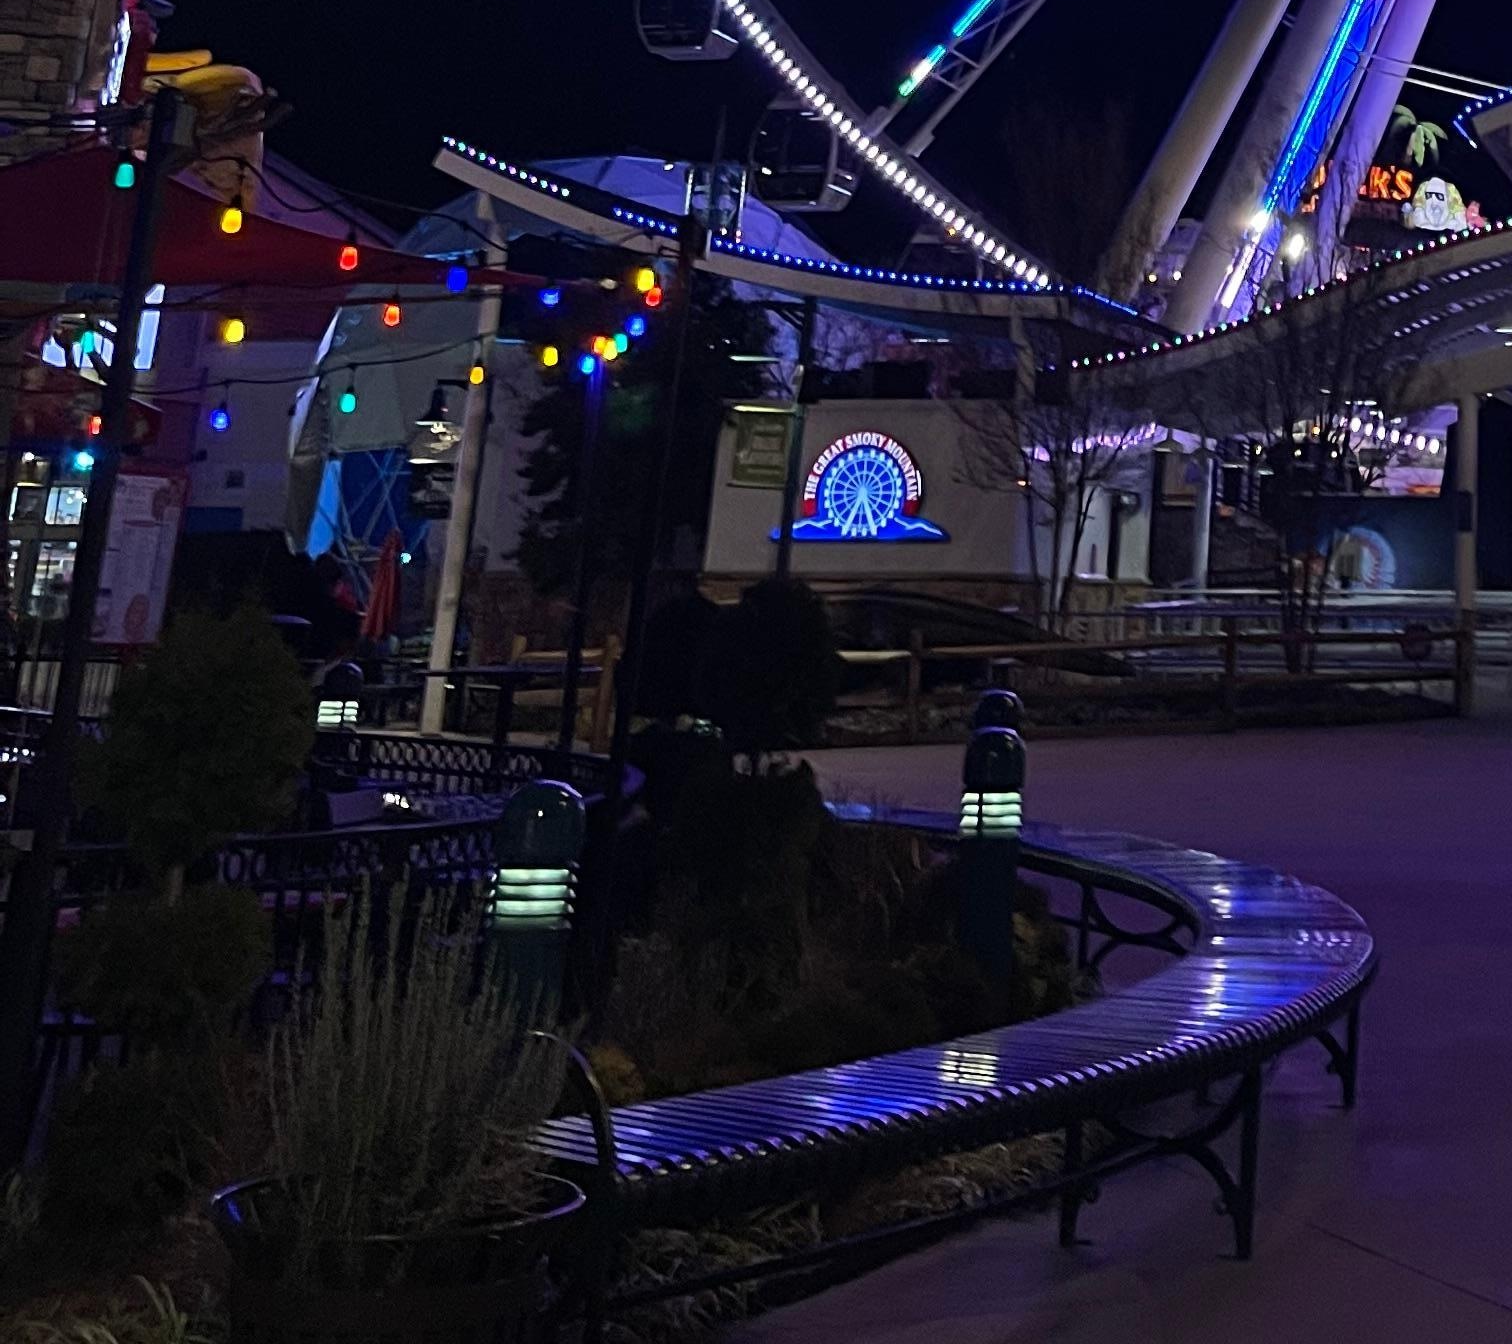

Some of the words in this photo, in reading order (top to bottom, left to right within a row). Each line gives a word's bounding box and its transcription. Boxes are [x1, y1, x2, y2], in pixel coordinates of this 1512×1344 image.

[804, 474, 820, 500] THE
[813, 439, 845, 475] GREAT
[844, 432, 887, 449] SMOKY
[883, 439, 918, 500] MOUNTAIN
